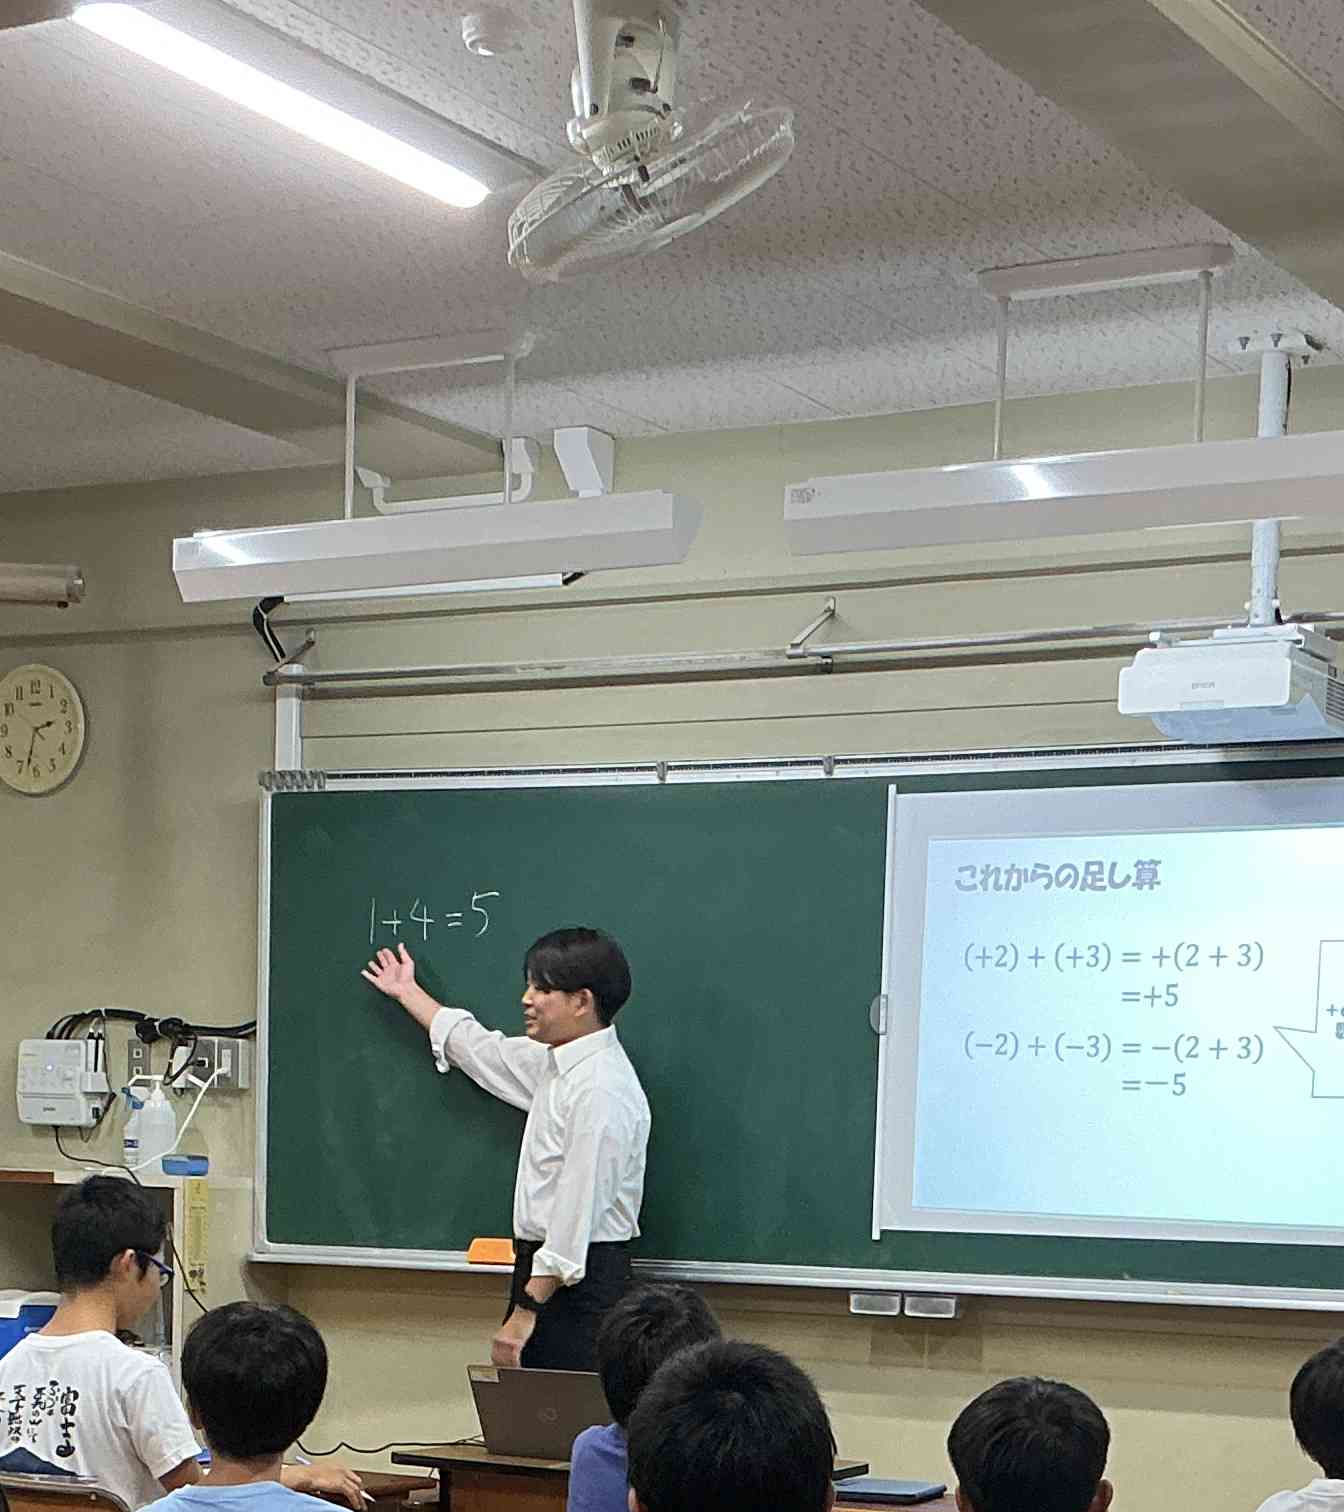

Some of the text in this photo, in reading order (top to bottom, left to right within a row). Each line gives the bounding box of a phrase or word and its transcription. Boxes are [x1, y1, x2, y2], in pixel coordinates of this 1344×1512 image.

[954, 859, 1162, 892] これからの足し算
